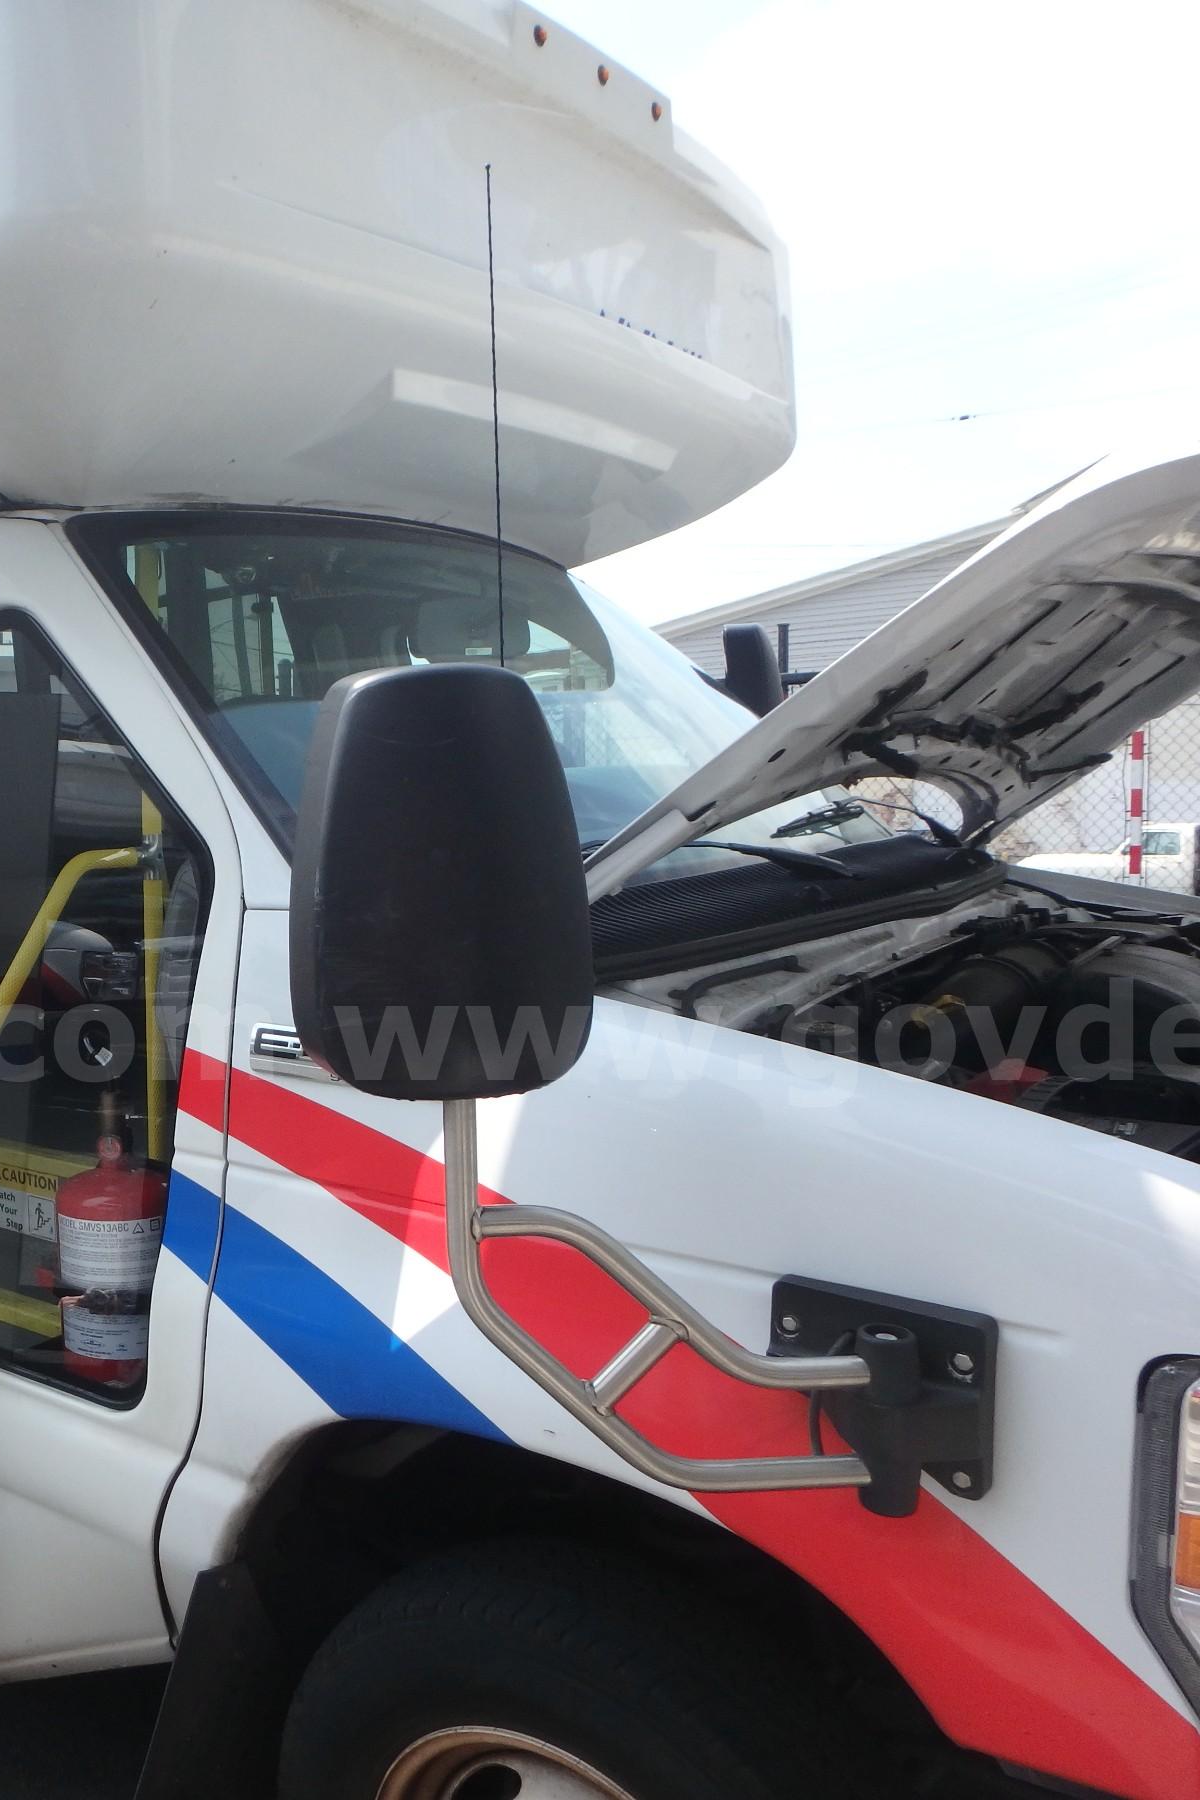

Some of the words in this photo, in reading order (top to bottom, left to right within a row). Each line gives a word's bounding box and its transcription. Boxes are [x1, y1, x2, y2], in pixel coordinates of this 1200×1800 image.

[1, 1167, 57, 1192] CAUTION
[0, 1202, 18, 1216] Your
[6, 1217, 23, 1231] Step
[78, 1221, 129, 1233] SMVS13ABC
